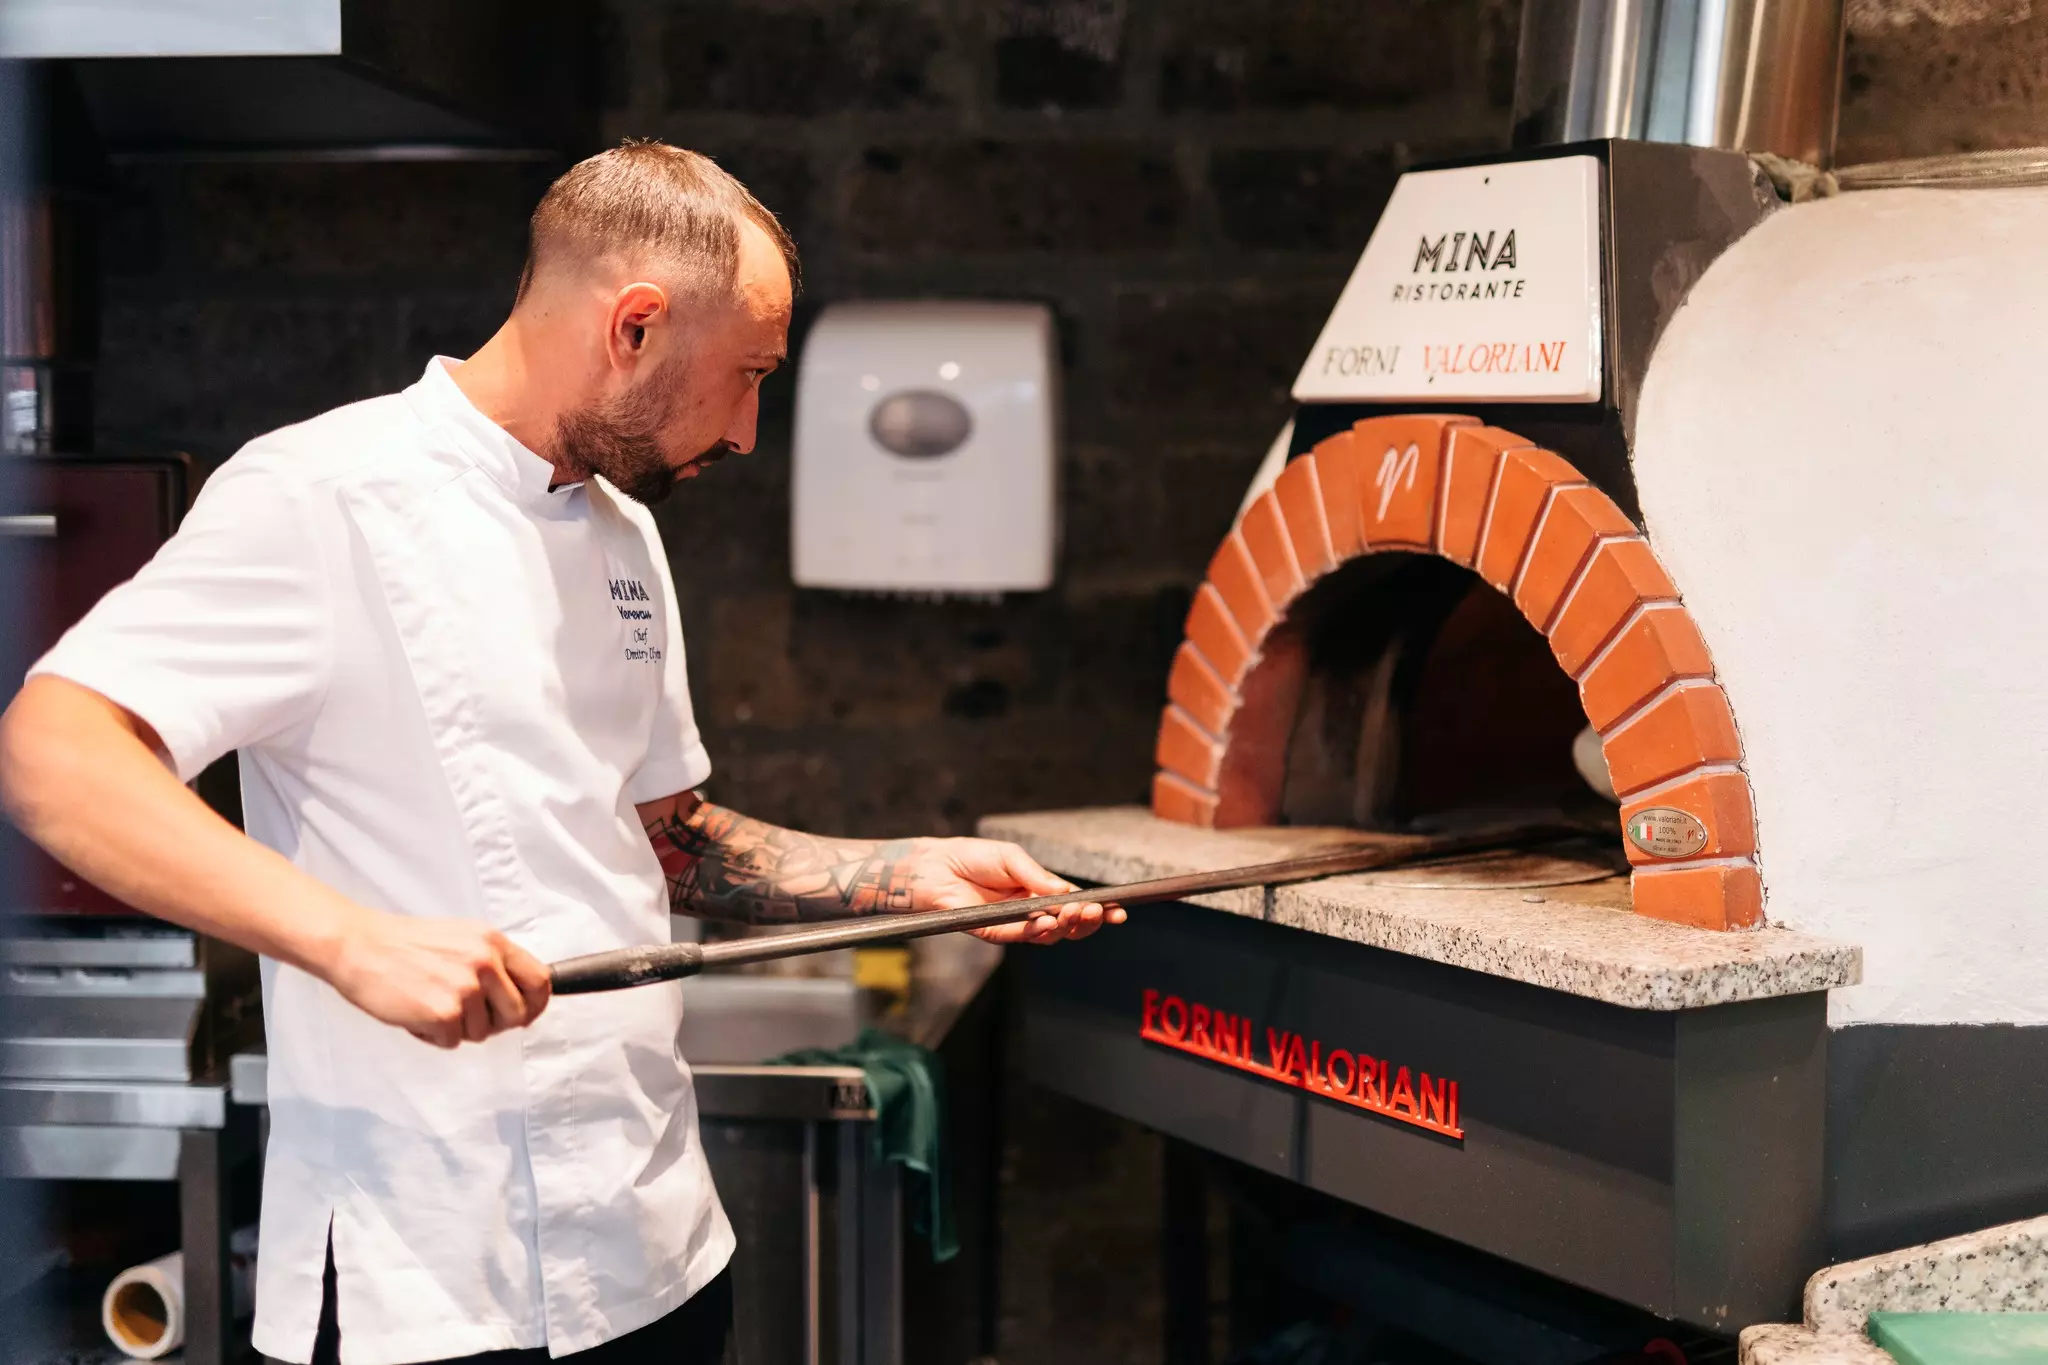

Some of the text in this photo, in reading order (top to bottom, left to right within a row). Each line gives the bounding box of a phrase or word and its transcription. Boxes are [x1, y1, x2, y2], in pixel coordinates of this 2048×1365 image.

[1412, 229, 1517, 273] MINA
[1392, 279, 1526, 304] RISTORANTE
[1321, 341, 1568, 376] FORNI VALORIANI
[608, 578, 650, 601] MINA
[633, 628, 648, 645] Chef
[625, 648, 648, 663] Dmitry
[1658, 826, 1677, 835] 100%
[1142, 988, 1461, 1133] FORNI VALORIANI
